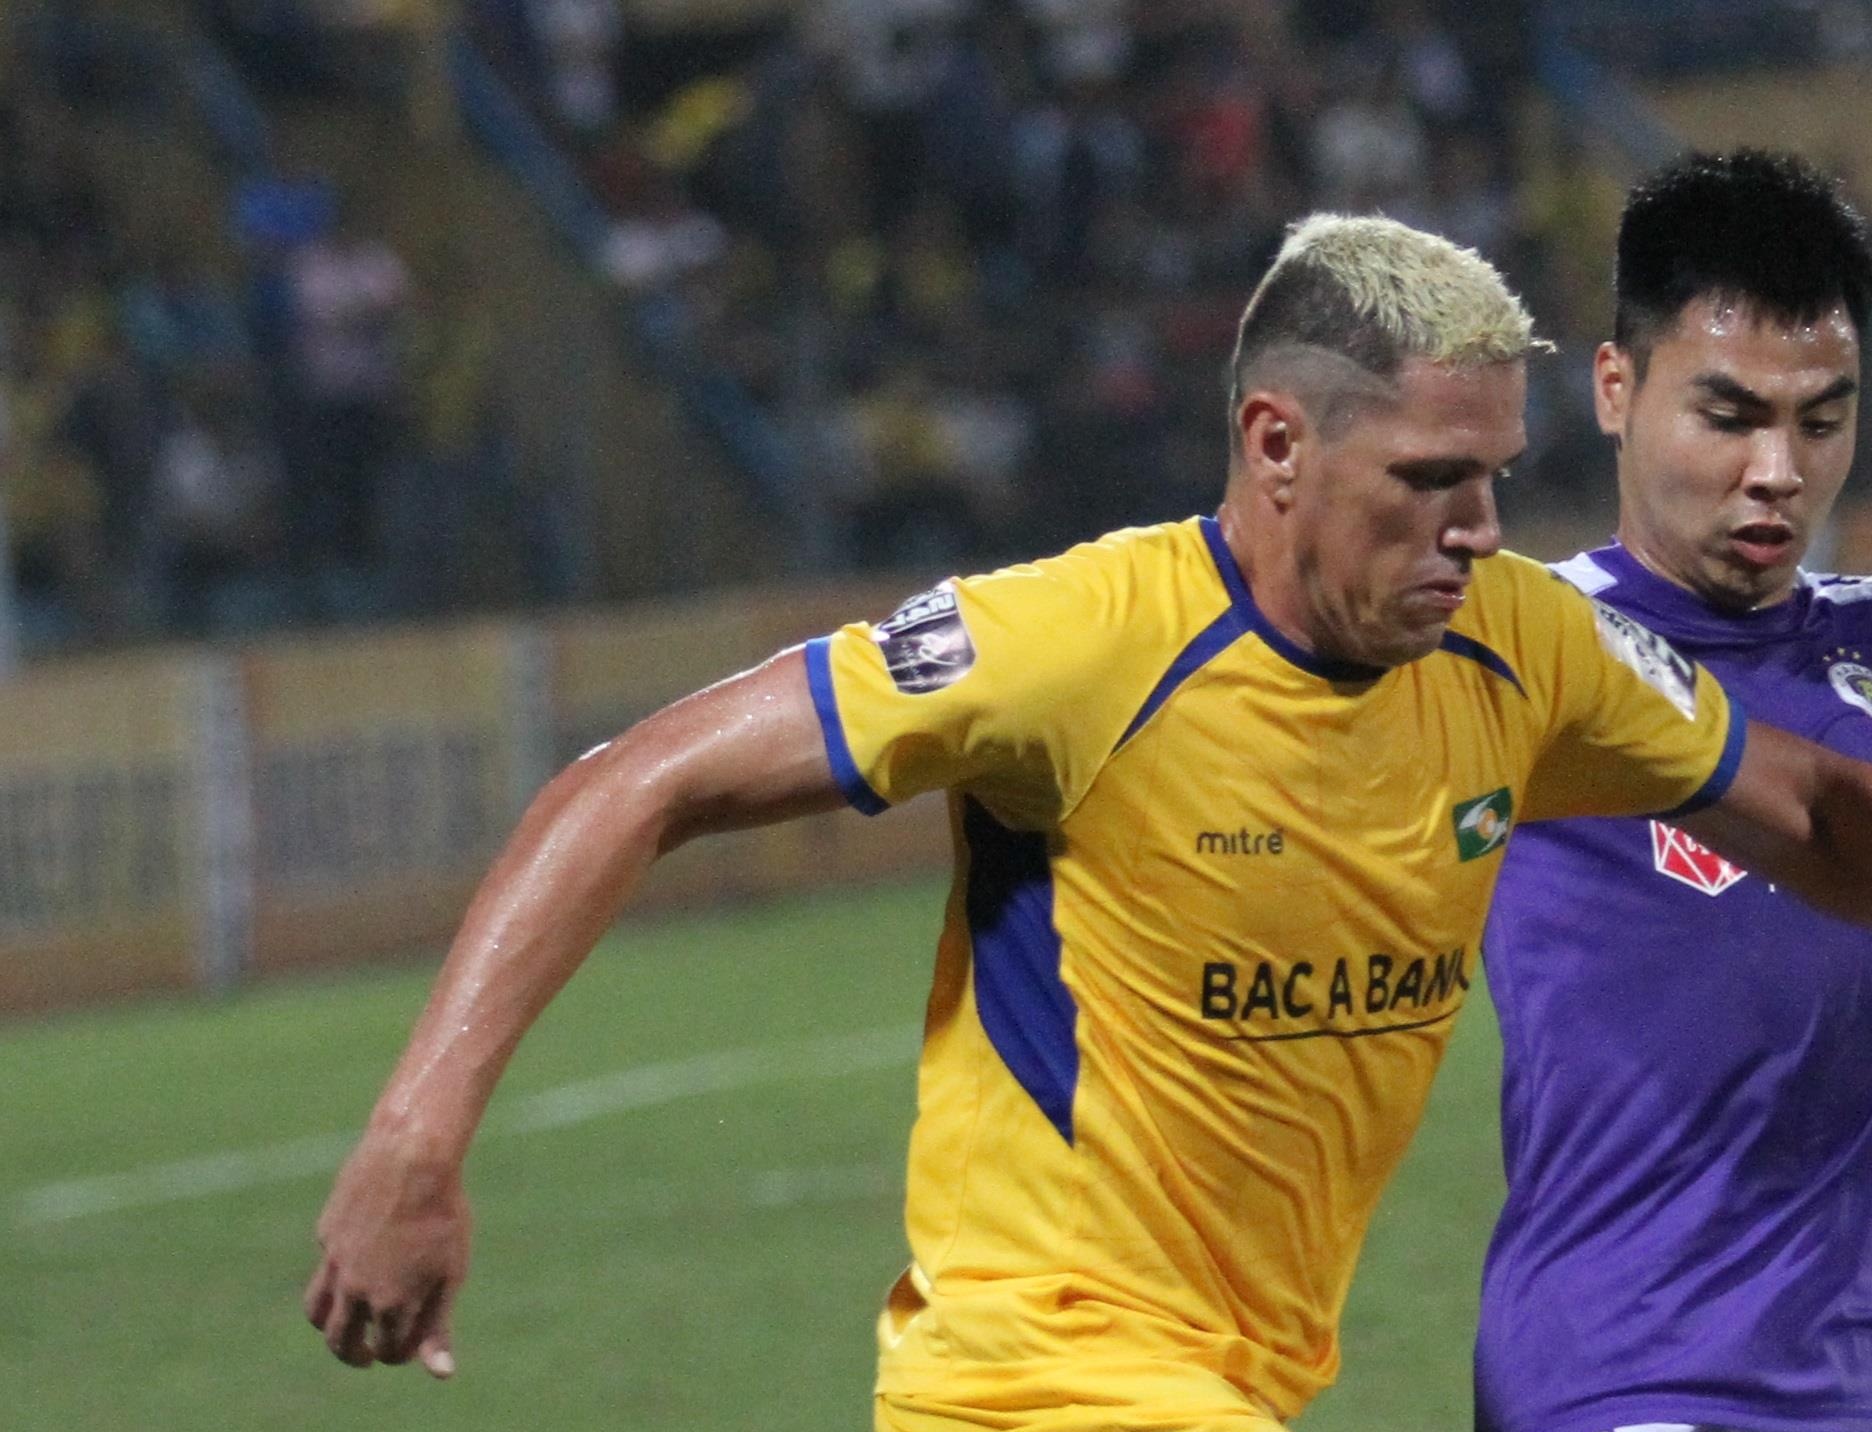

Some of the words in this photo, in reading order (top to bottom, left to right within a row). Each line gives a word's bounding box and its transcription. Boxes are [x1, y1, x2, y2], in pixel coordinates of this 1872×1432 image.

[1195, 826, 1284, 855] mitre
[1201, 960, 1313, 1020] BAC
[1327, 956, 1354, 1019] A
